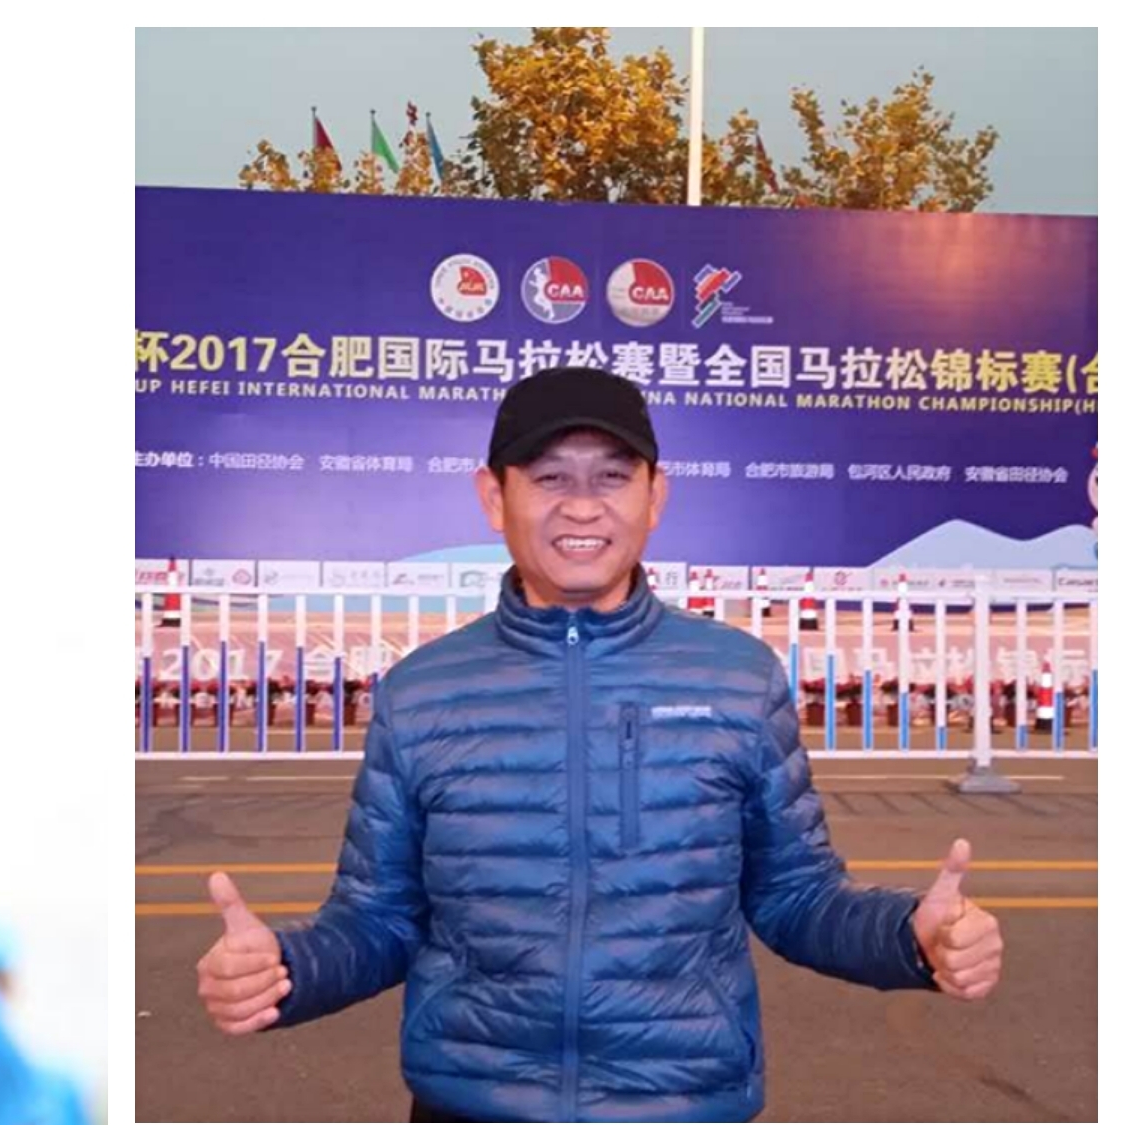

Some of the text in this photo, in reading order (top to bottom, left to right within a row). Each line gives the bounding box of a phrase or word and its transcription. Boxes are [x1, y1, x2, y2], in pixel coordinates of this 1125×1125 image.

[546, 282, 584, 300] CAA
[632, 286, 670, 301] CAA
[170, 380, 231, 396] HEFEI
[238, 381, 411, 400] INTERNATIONAL
[418, 386, 507, 401] MARATH
[684, 391, 789, 408] NATIONAL
[795, 394, 911, 410] MARATHON
